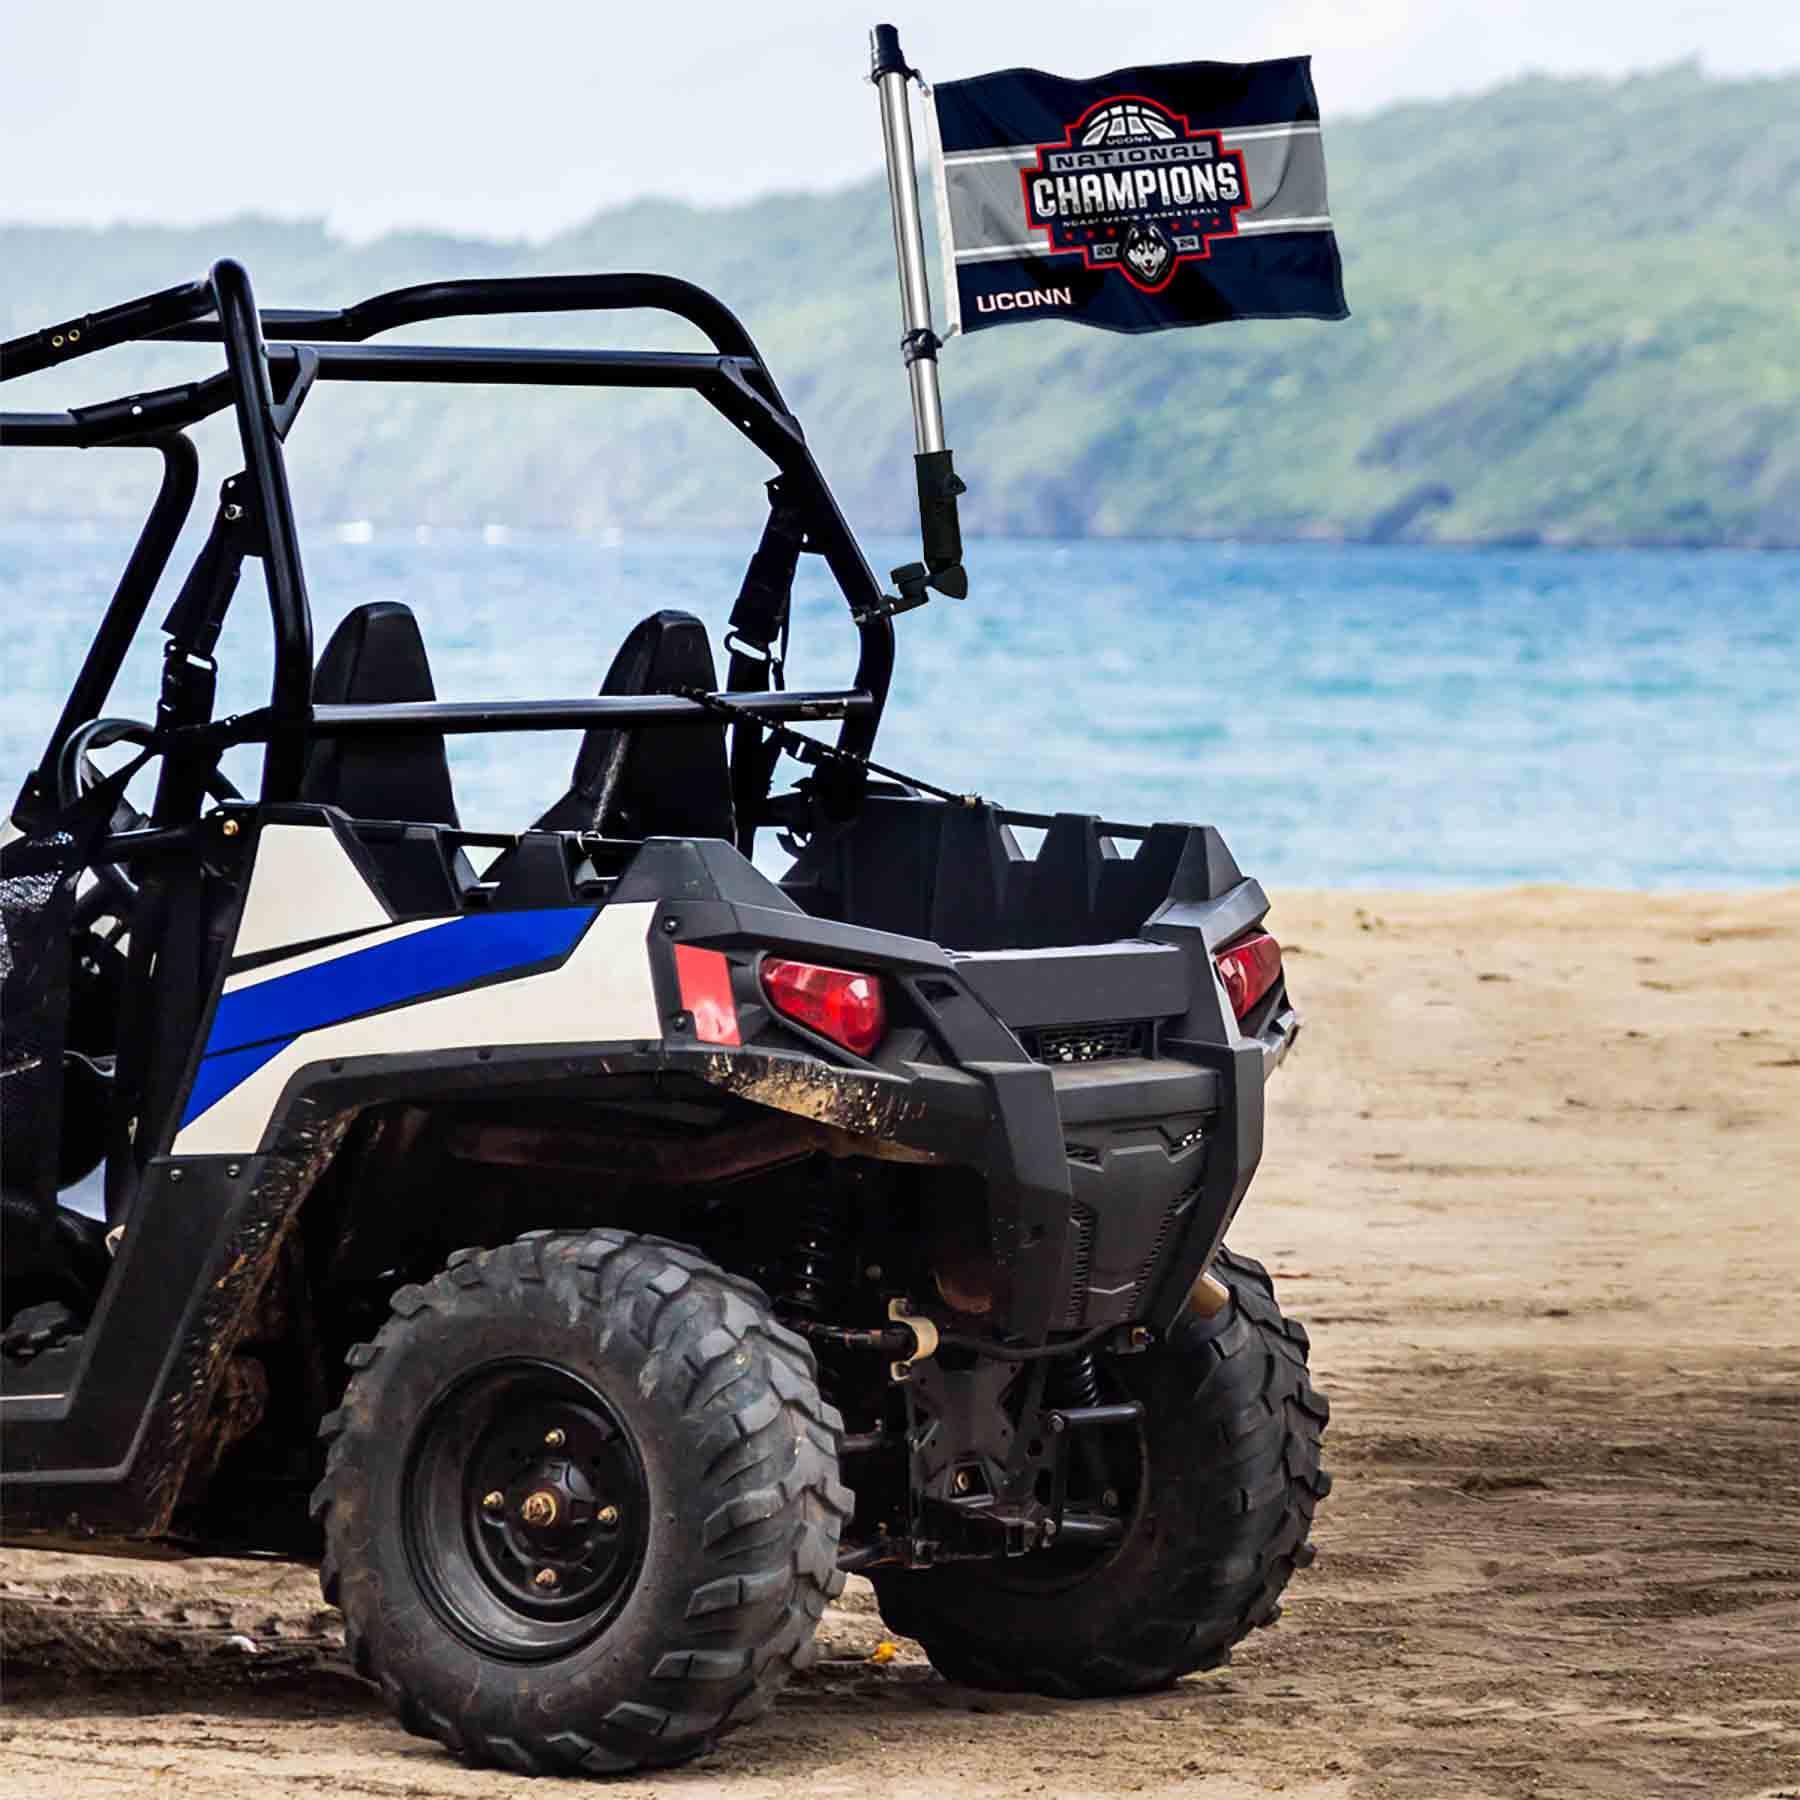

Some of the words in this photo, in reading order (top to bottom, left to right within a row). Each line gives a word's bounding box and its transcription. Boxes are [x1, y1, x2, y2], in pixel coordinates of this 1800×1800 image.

[1056, 145, 1207, 169] NATIONAL
[1032, 162, 1240, 217] CHAMPIONS
[976, 287, 1072, 313] UCONN
